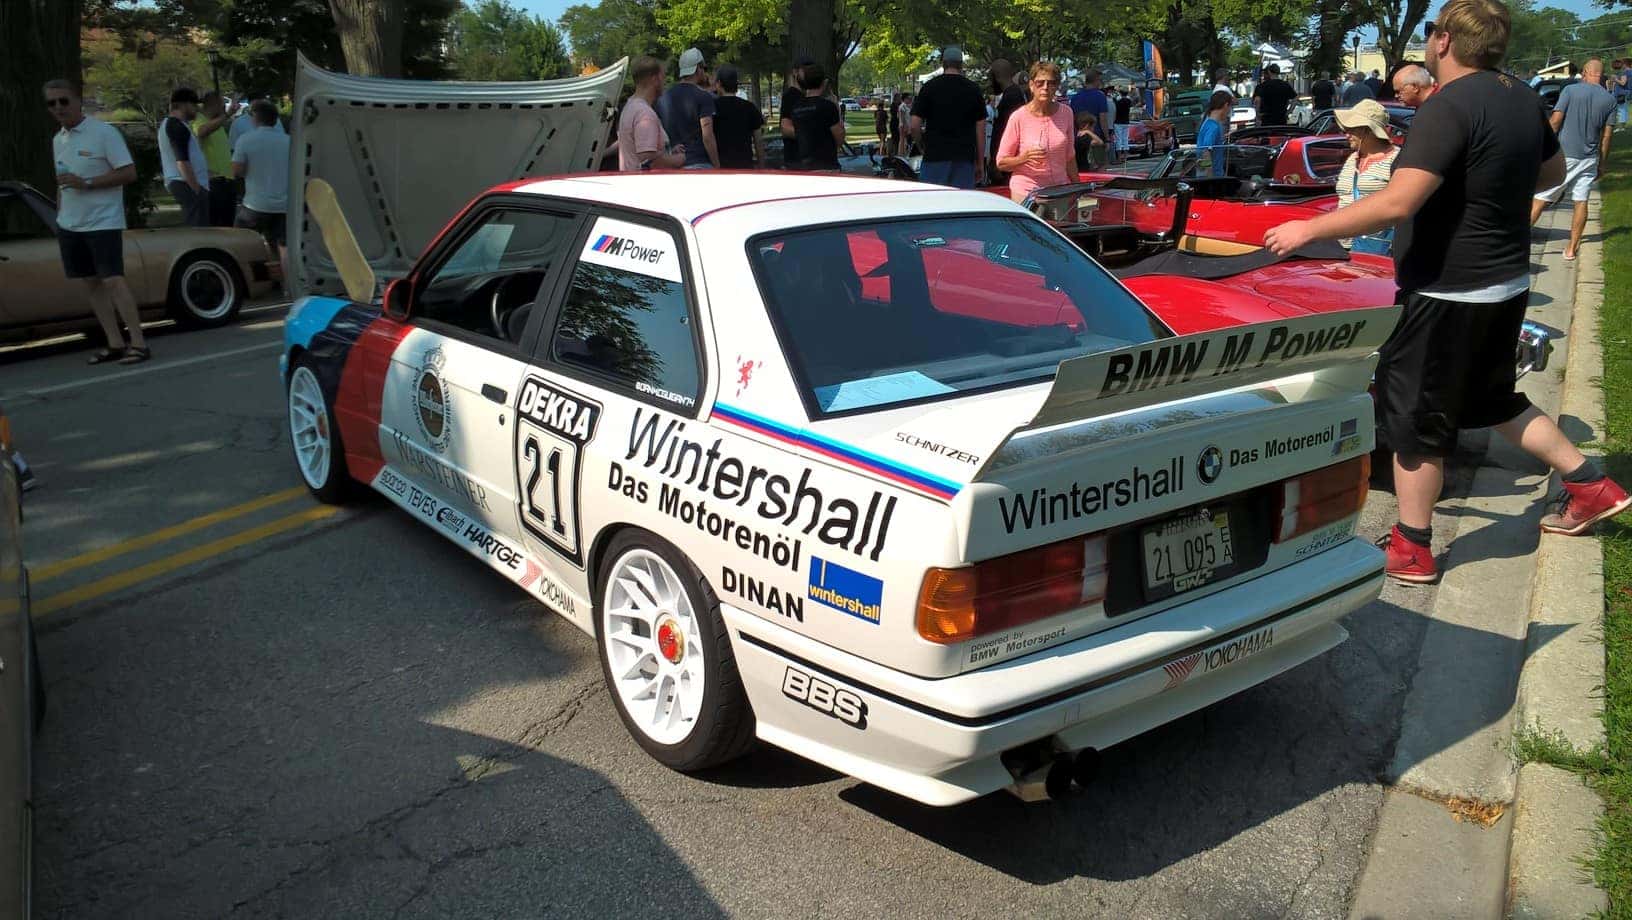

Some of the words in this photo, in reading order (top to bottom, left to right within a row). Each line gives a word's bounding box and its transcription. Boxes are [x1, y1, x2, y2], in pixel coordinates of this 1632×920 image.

[1097, 339, 1210, 400] BMW
[1212, 331, 1256, 377] M
[1258, 318, 1368, 369] Power
[519, 381, 592, 441] DEKRA
[894, 431, 981, 467] SCHNITZER
[1229, 446, 1259, 468] Das
[1264, 424, 1335, 459] Motorenöl
[407, 486, 437, 517] TEVES
[523, 435, 567, 538] 21
[624, 406, 898, 563] Wintershall
[998, 456, 1185, 535] Wintershall
[608, 460, 650, 504] Das
[658, 482, 802, 573] Motorenöl
[463, 523, 524, 570] HARTGE
[1152, 545, 1175, 582] 21
[1183, 532, 1216, 573] 095
[538, 573, 578, 619] YOKOHAMA
[721, 566, 805, 623] DINAN
[808, 584, 881, 622] wintershall
[969, 646, 1000, 664] BMW
[1006, 626, 1066, 654] Motorsport
[970, 633, 1010, 653] powered
[1013, 631, 1024, 642] by
[1202, 627, 1274, 673] YOKOHAMA
[781, 665, 870, 731] BBS
